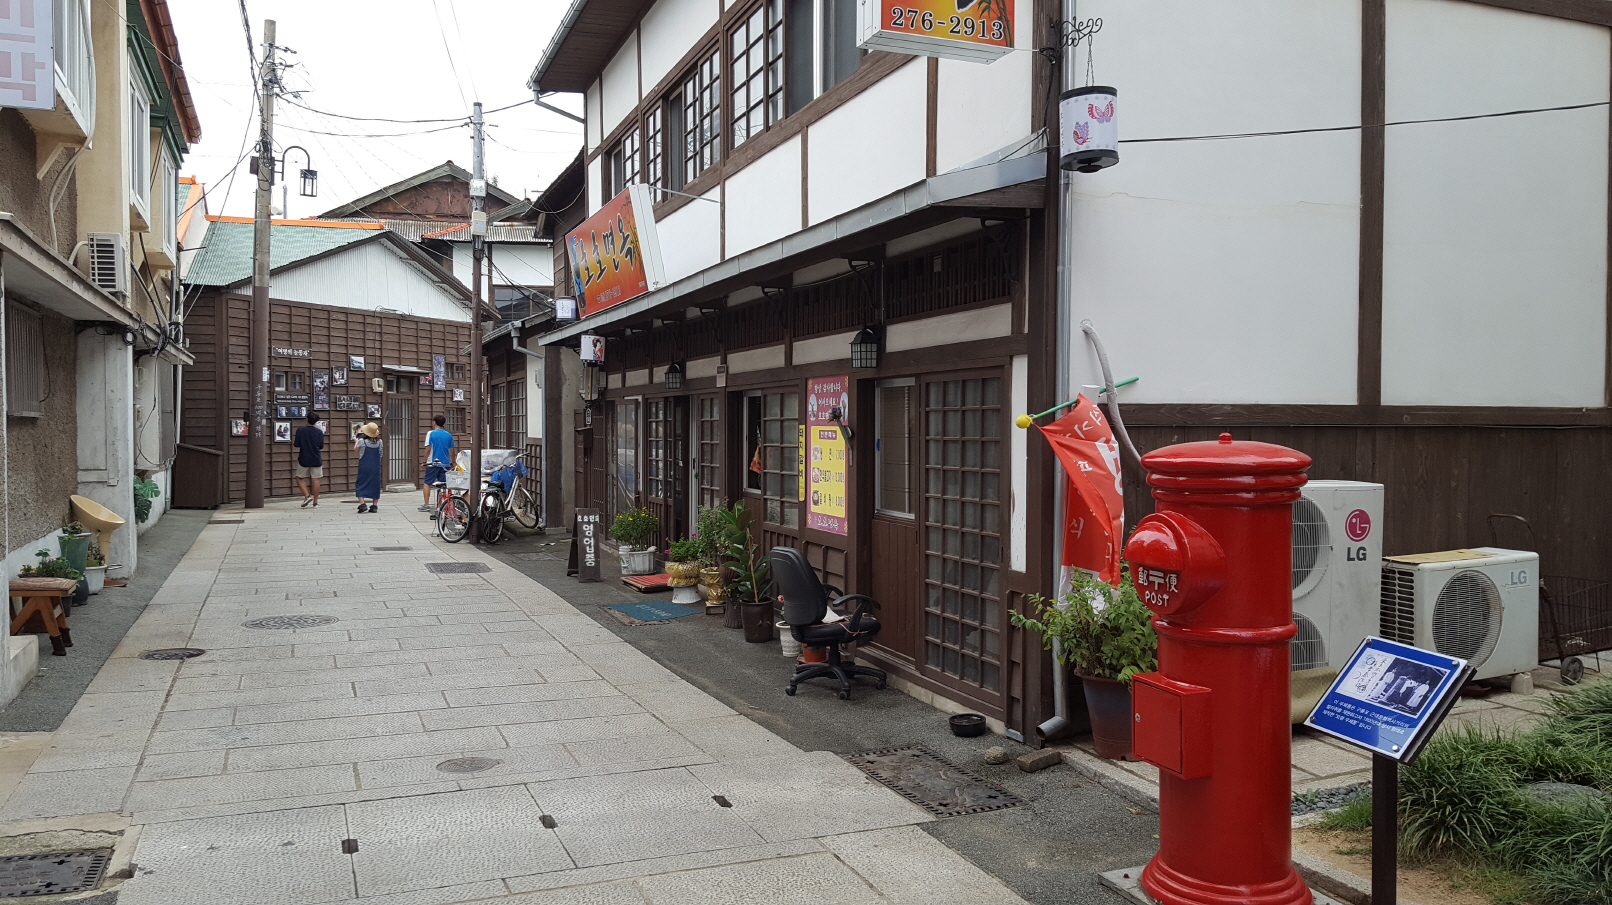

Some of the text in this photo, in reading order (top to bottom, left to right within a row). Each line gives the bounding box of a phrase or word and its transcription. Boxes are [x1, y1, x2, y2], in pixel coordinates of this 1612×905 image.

[891, 7, 1005, 40] 276-2913
[582, 523, 596, 567] 영업중
[1346, 546, 1367, 561] LG
[1510, 570, 1528, 586] LG
[1145, 592, 1170, 607] POST
